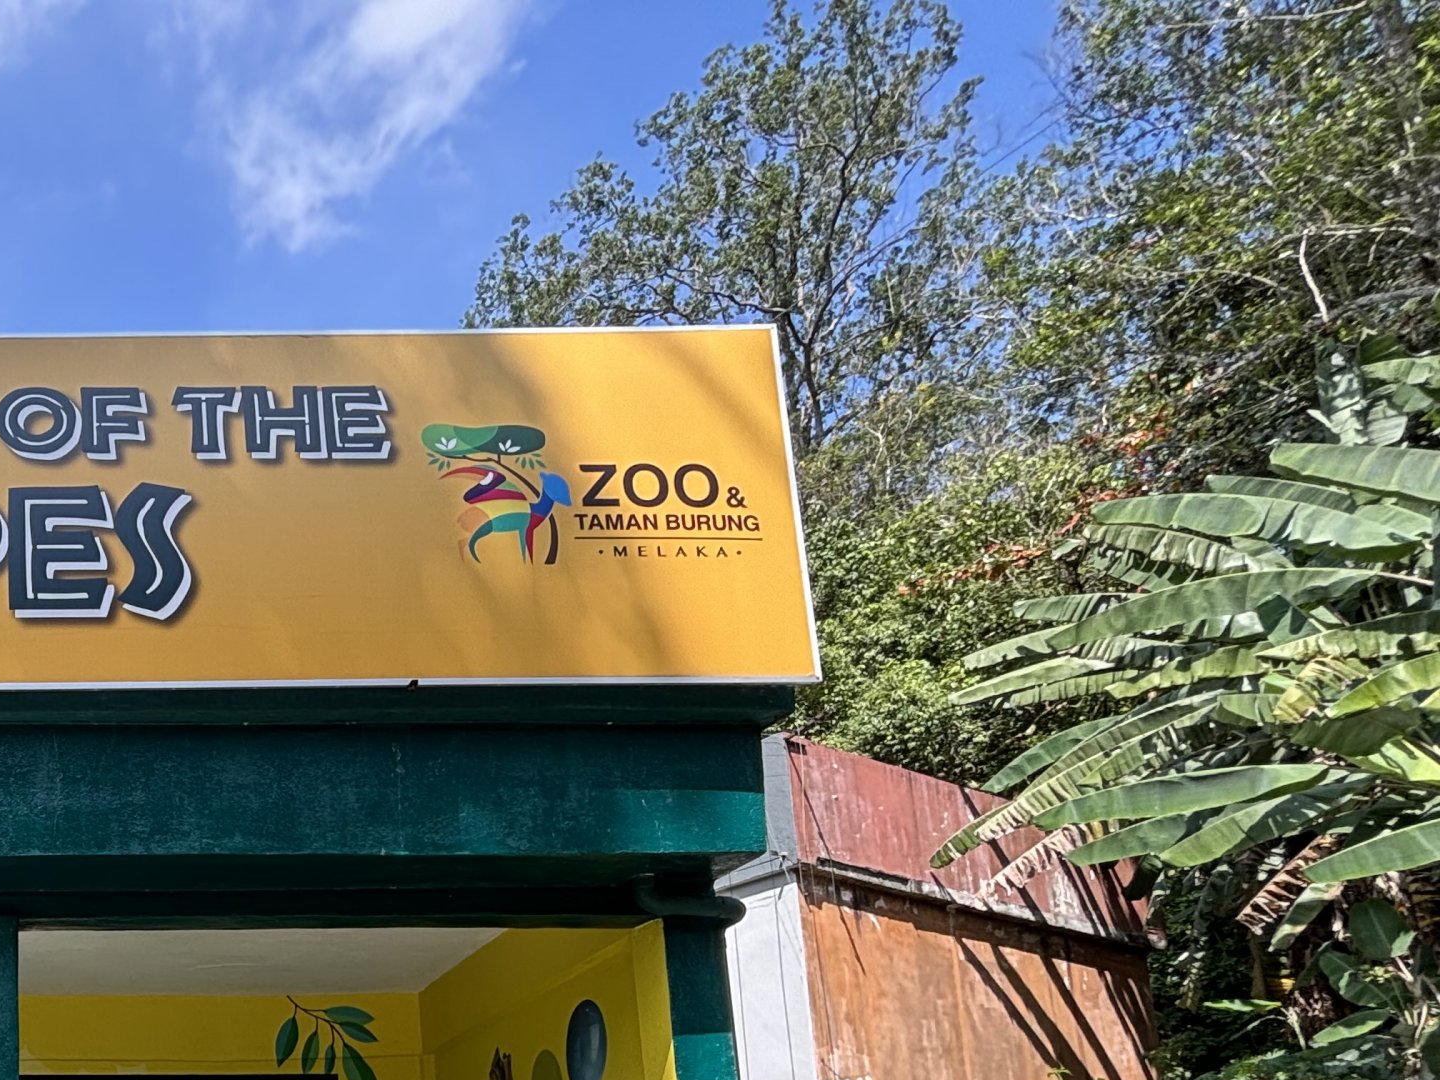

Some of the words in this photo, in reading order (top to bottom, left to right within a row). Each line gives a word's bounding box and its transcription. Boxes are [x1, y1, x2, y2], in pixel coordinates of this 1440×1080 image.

[171, 385, 391, 460] THE
[579, 463, 719, 508] ZOO
[726, 486, 747, 508] &
[574, 513, 658, 531] TAMAN
[665, 513, 760, 532] BURUNG
[613, 545, 729, 558] MELAKA
